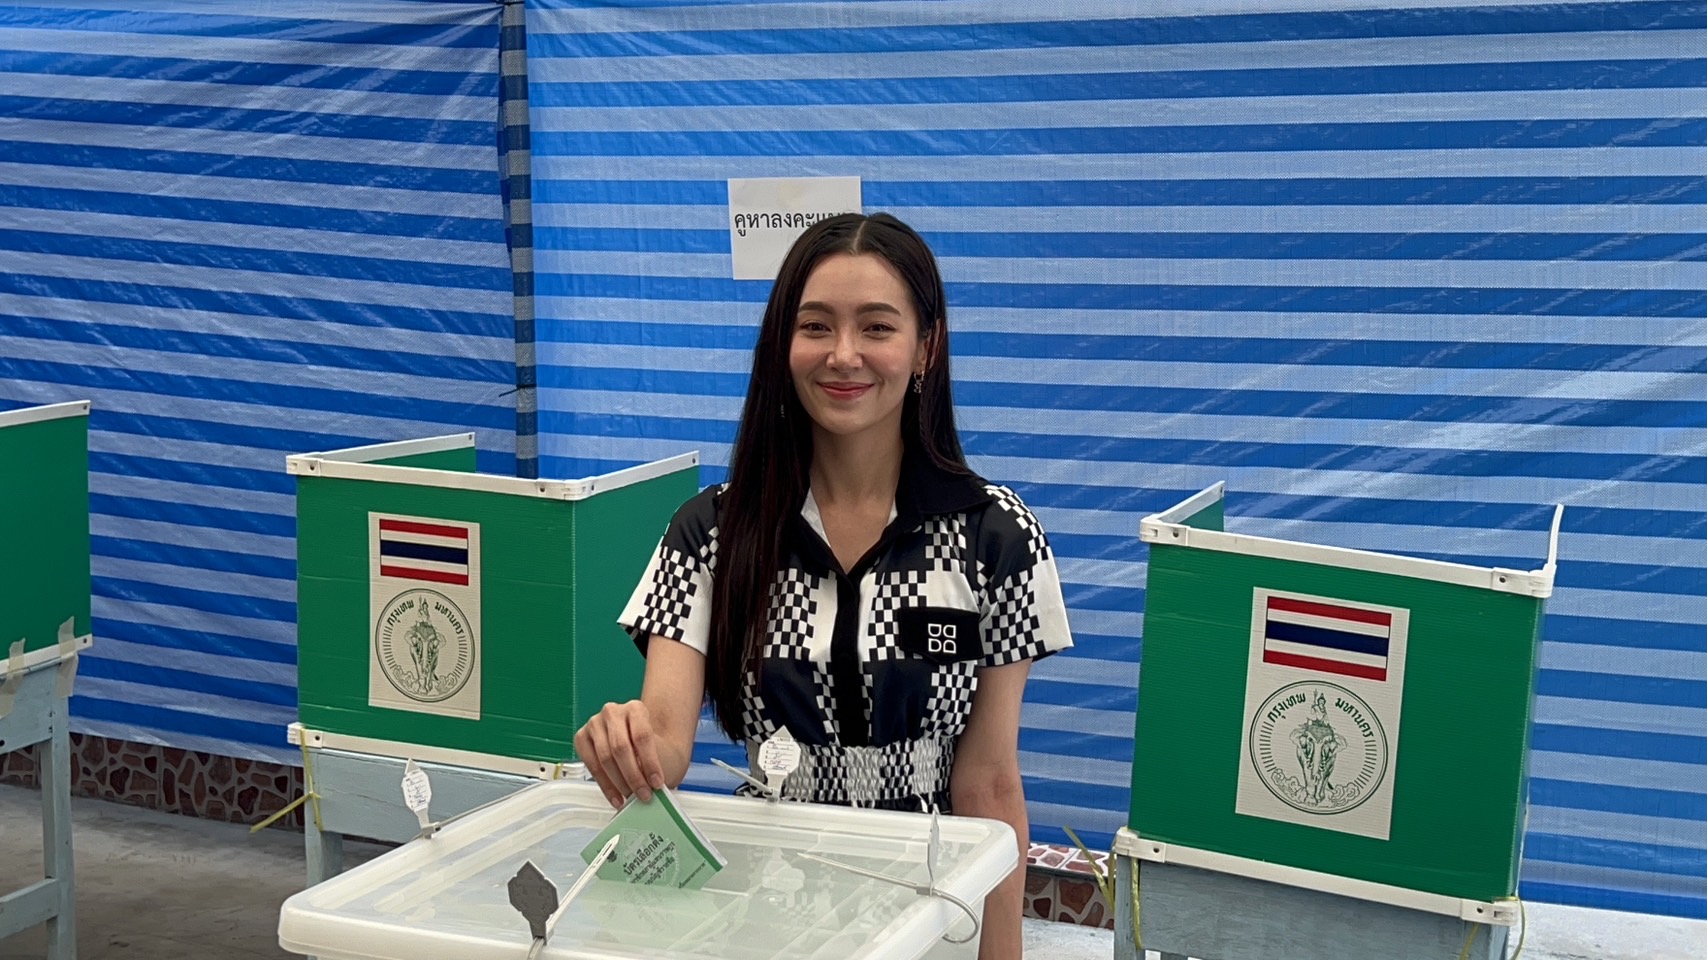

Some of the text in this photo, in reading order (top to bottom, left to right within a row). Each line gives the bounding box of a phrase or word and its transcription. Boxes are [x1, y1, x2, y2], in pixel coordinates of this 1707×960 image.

[387, 599, 465, 635] กรุงเทพ มหานคร
[1267, 692, 1374, 737] กรุงเทพ มหานคร
[623, 832, 664, 875] บัตรเลือกตั้ง
